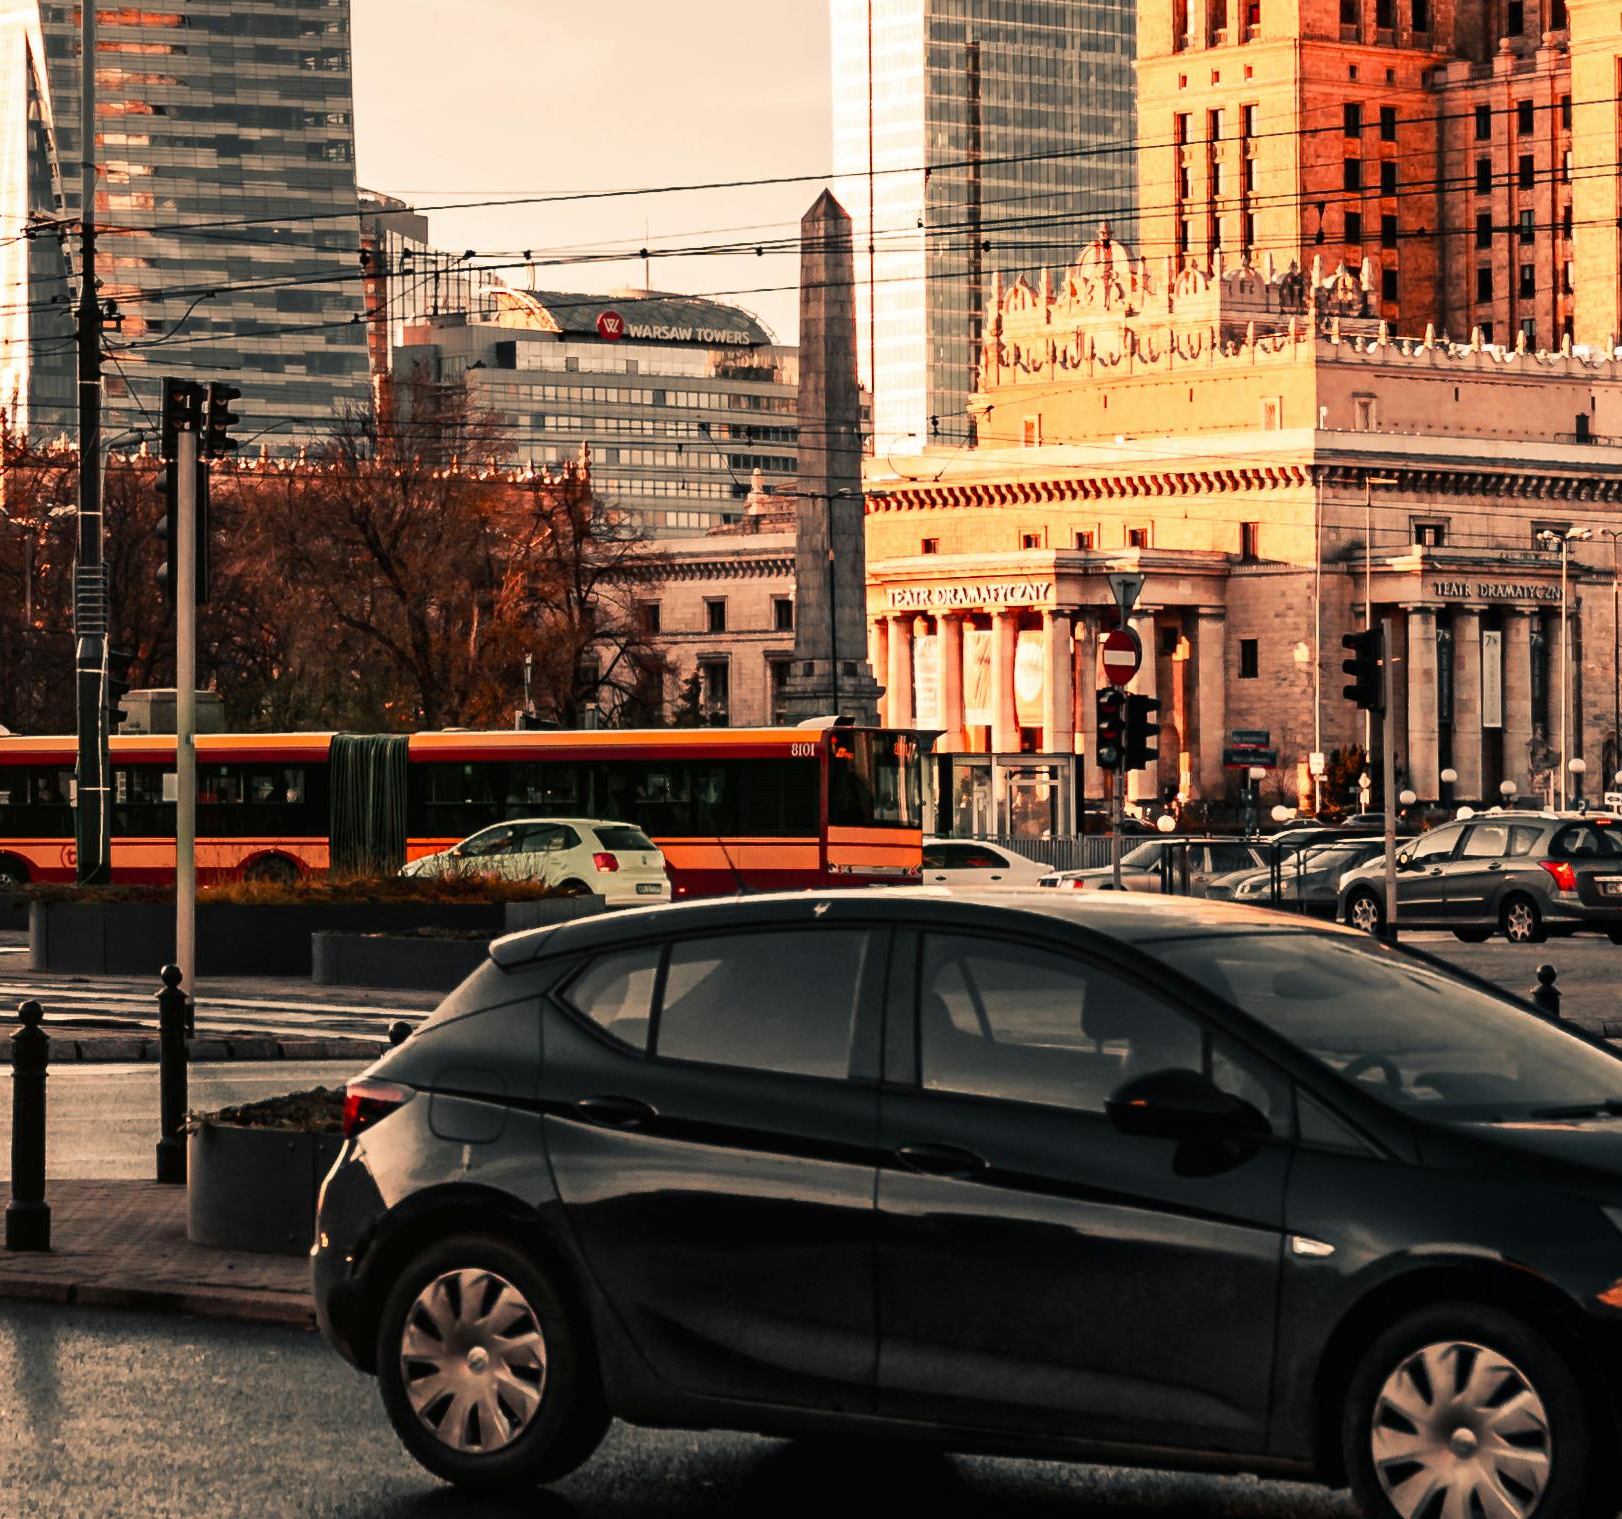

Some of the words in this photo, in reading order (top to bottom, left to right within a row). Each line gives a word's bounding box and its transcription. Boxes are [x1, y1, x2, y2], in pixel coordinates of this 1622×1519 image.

[628, 324, 692, 340] WARSAW
[696, 328, 750, 344] TOWERS
[886, 588, 933, 607] TEATR
[935, 582, 1053, 606] DRAMATYCZNY
[1435, 581, 1472, 597] TEATR
[791, 743, 816, 757] 8101
